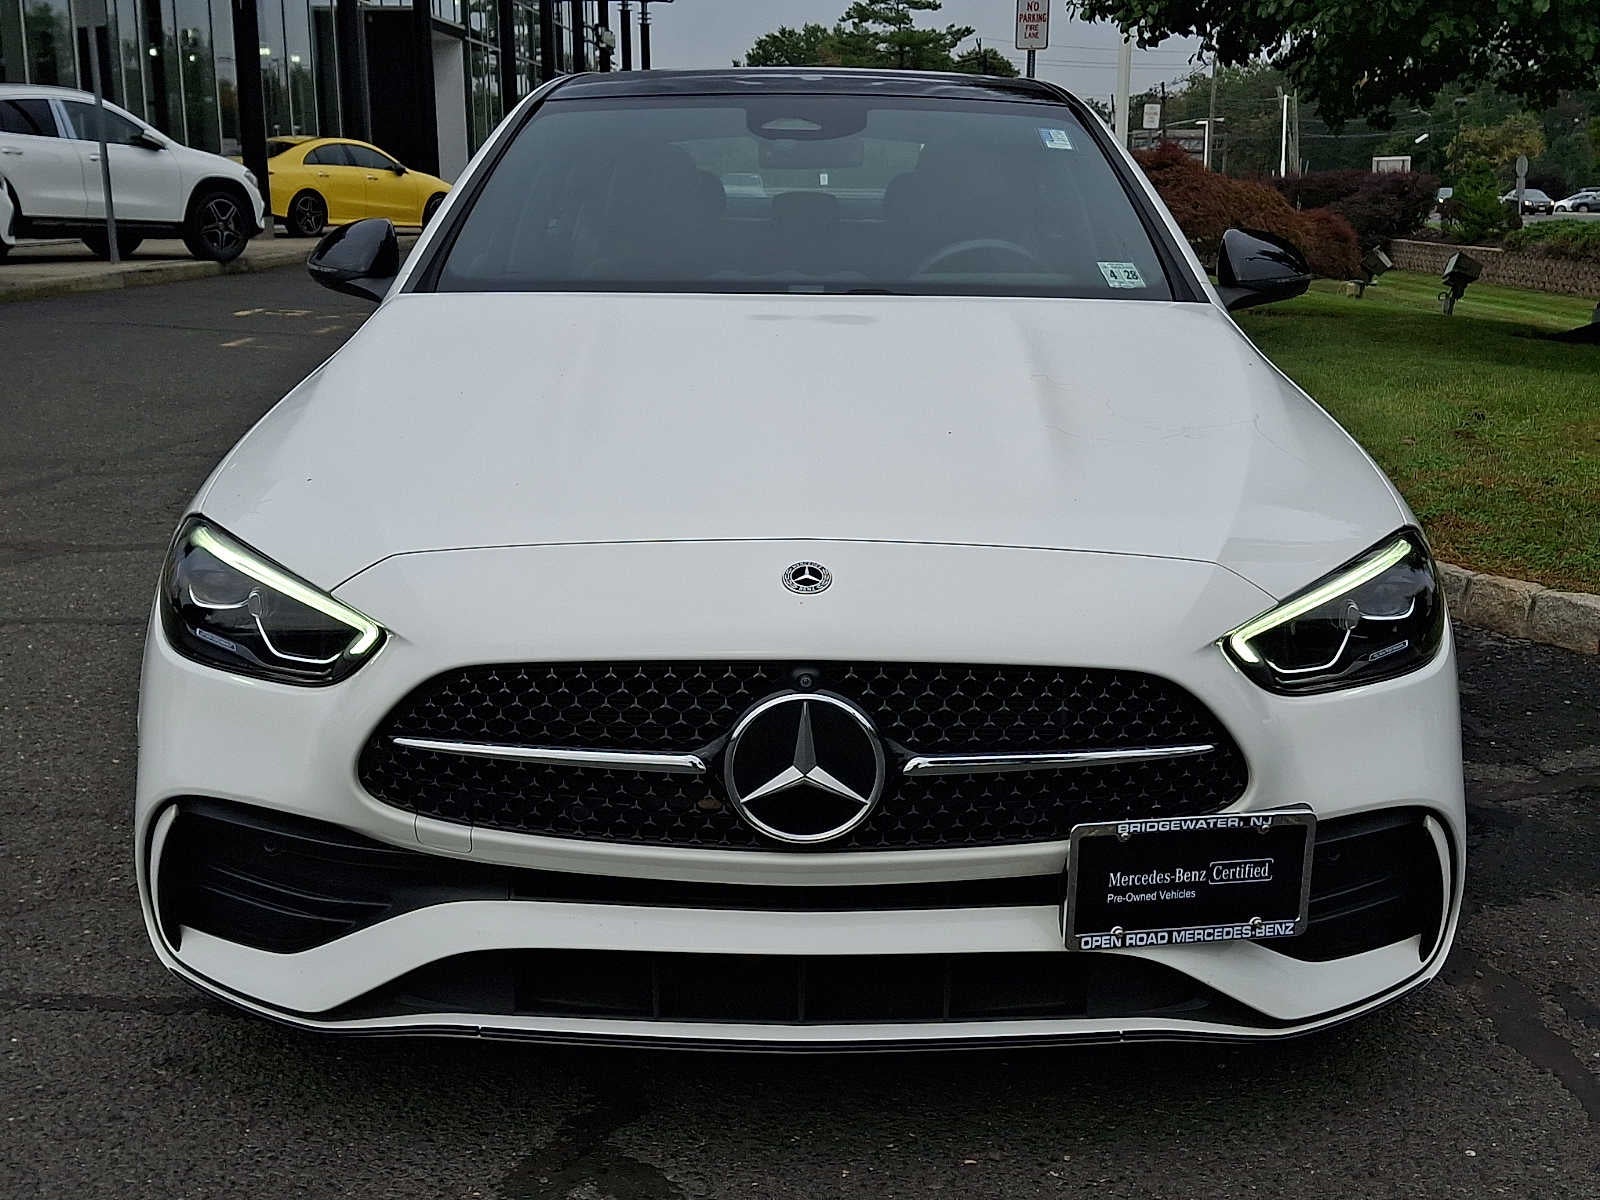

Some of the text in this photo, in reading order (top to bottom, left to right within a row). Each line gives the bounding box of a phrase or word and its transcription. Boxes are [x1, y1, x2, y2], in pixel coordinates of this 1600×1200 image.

[1027, 1, 1040, 11] NO
[1019, 13, 1046, 22] PARKING
[1110, 270, 1138, 280] 4 28
[1249, 816, 1273, 828] NJ
[1108, 862, 1269, 887] Mercedes-Benz Certified
[1106, 888, 1196, 904] Pre-Owned Vehicles
[1081, 935, 1122, 950] OPEN
[1125, 932, 1169, 946] ROAD
